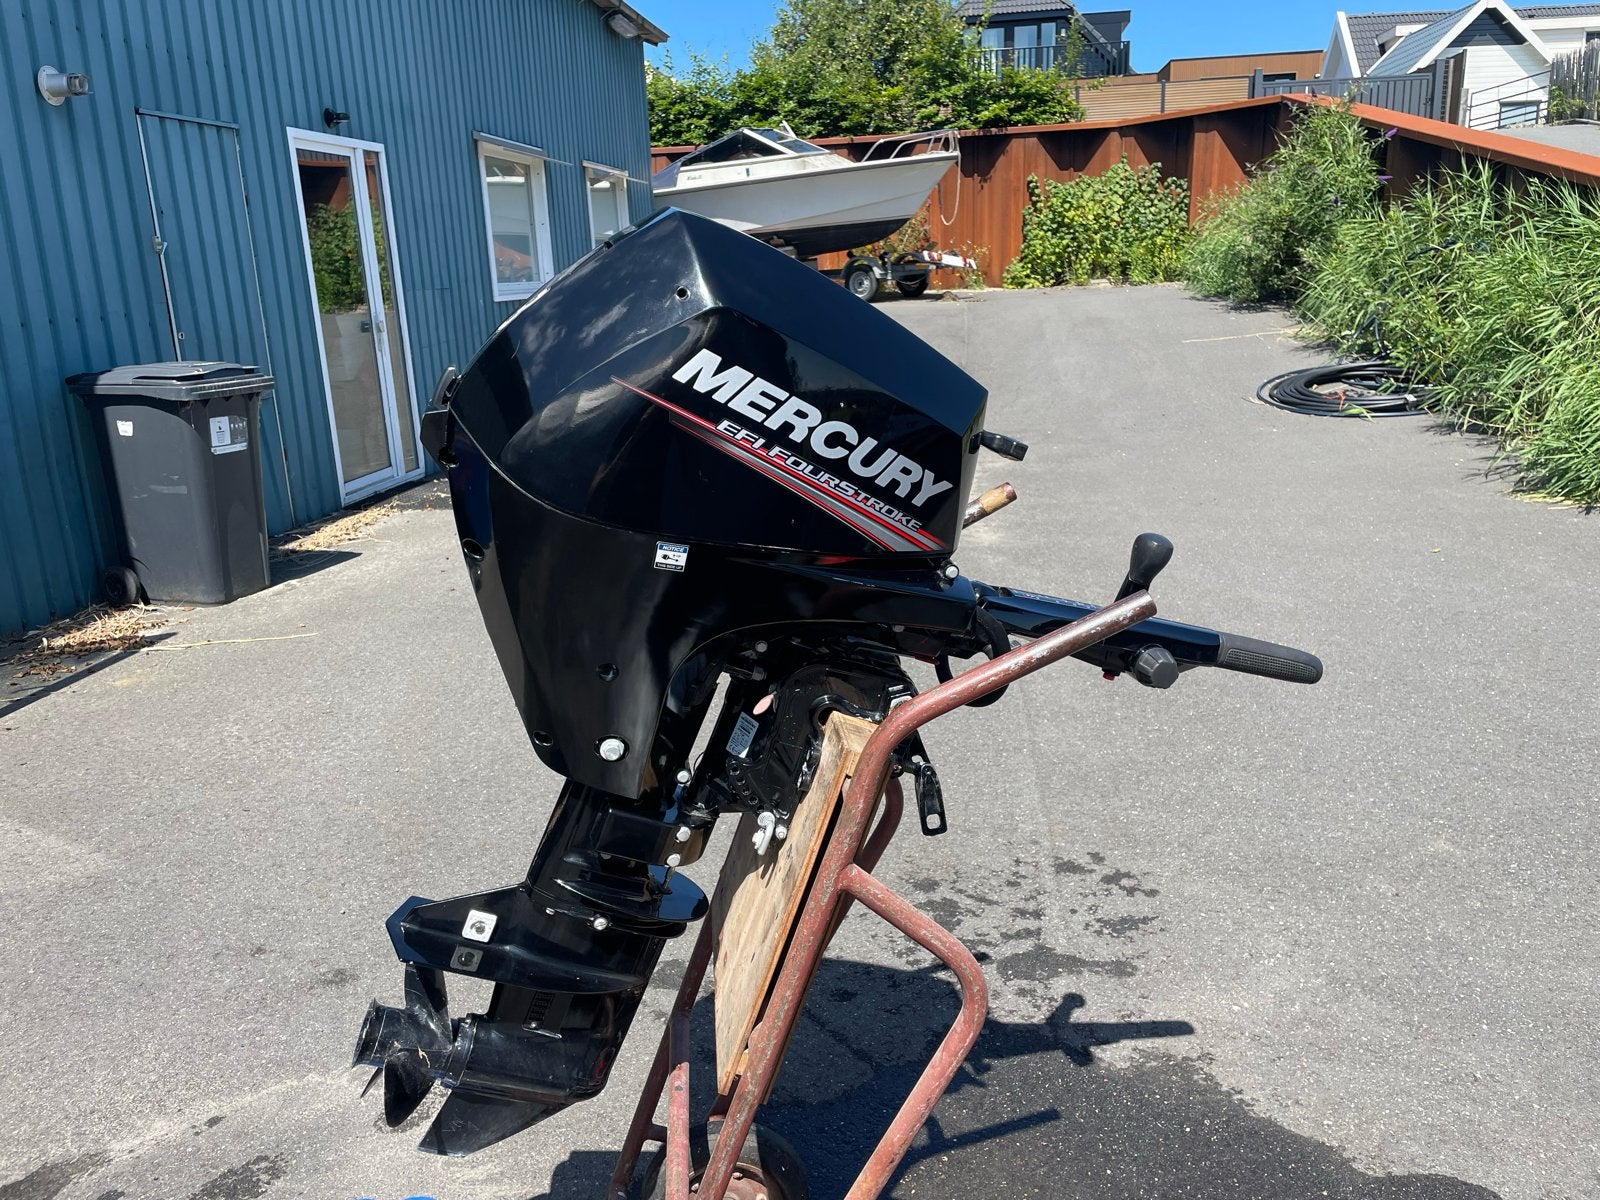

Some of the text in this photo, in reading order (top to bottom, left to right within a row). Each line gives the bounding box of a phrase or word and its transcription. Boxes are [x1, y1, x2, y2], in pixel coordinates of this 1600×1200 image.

[671, 348, 953, 508] MERCURY
[716, 418, 922, 532] EFI FOURSTROKE
